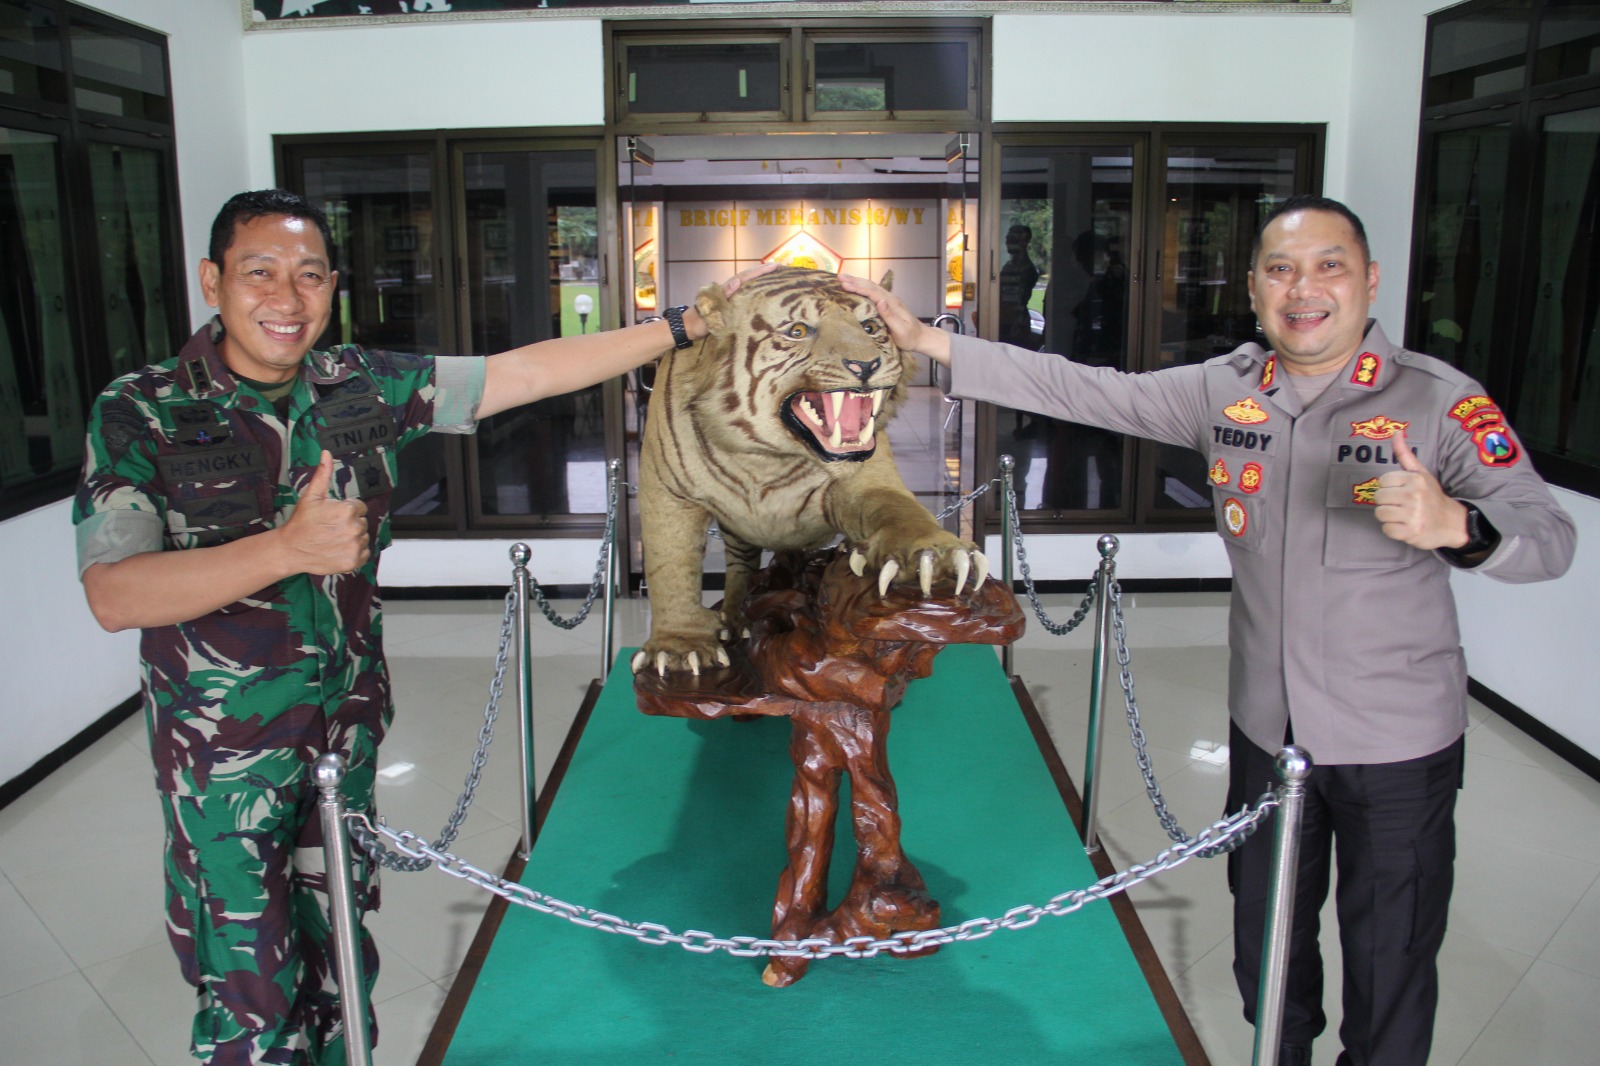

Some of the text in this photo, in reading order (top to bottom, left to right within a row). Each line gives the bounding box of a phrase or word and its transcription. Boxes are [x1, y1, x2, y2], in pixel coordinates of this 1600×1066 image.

[680, 208, 750, 227] BRIGIF
[756, 207, 862, 226] MEKANIS
[866, 206, 926, 227] 16/WY
[330, 424, 388, 448] TNI AD
[1213, 425, 1272, 452] TEDDY
[169, 452, 252, 478] HENGKY
[1337, 444, 1418, 465] POLI
